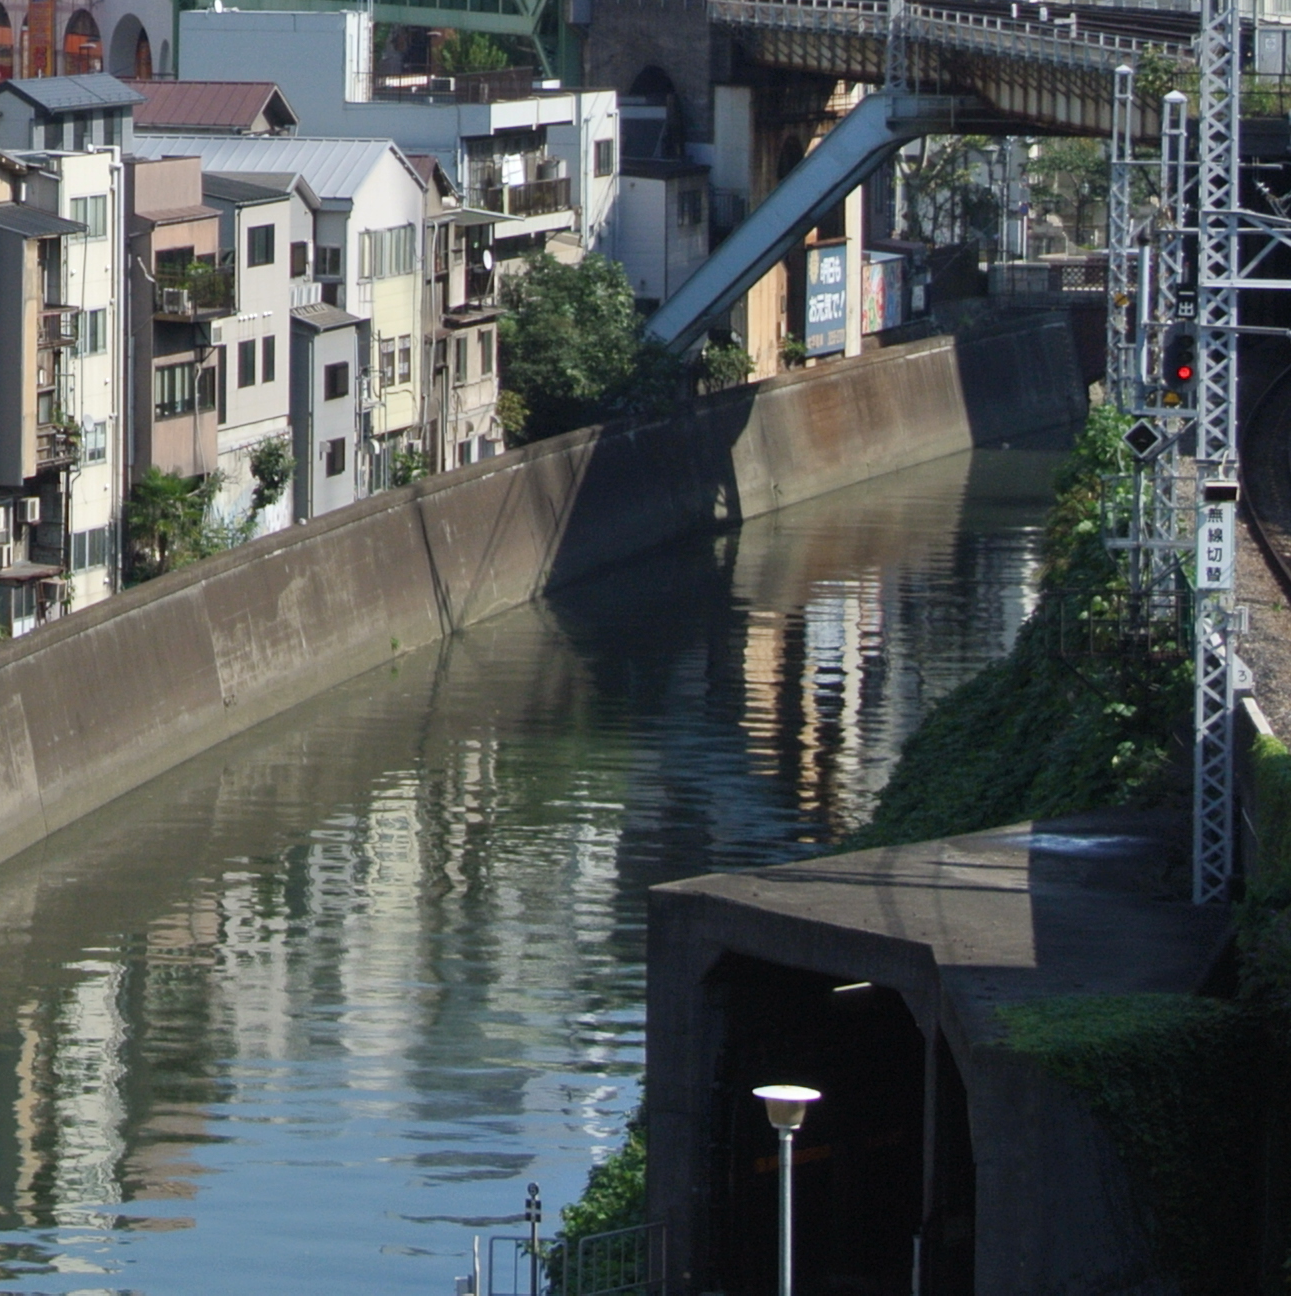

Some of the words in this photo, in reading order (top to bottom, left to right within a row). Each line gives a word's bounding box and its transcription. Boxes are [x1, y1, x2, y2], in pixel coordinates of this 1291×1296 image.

[820, 256, 842, 285] 明日も
[1206, 508, 1224, 582] 無線切替
[1237, 669, 1247, 683] 3
